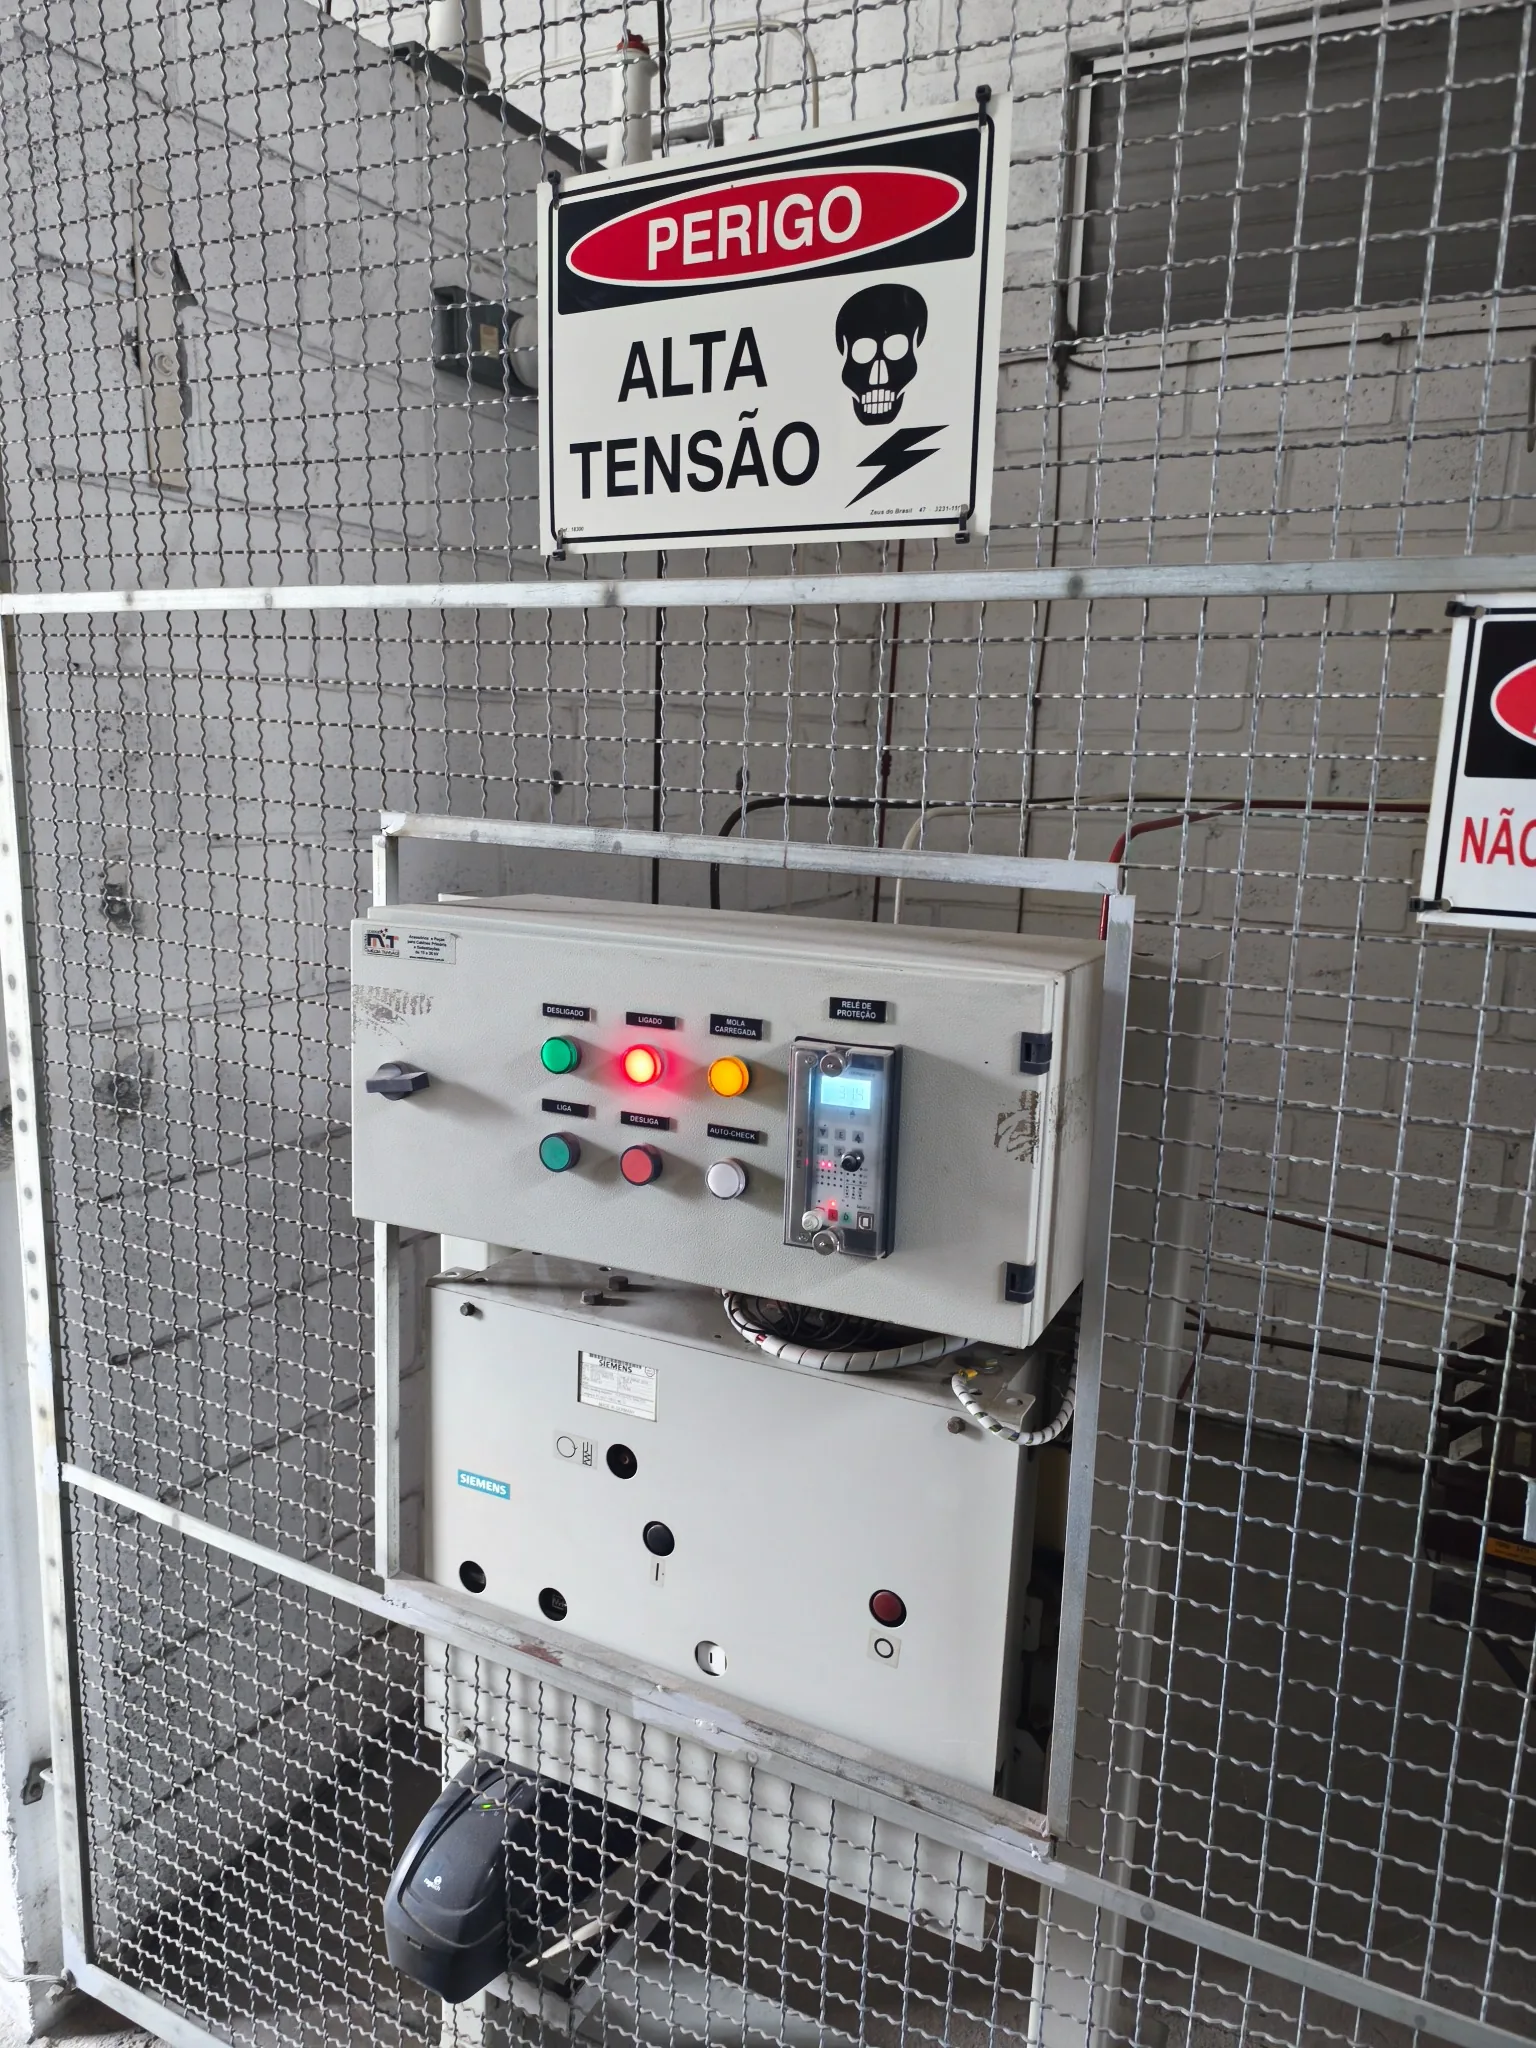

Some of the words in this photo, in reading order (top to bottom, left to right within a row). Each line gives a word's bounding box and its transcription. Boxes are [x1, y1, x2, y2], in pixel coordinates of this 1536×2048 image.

[647, 184, 863, 271] PERIGO
[617, 326, 768, 403] ALTA
[569, 407, 820, 500] TENSÃO
[546, 1006, 584, 1017] DESLIGADO
[861, 1002, 872, 1010] DE
[836, 1008, 877, 1020] PROTEÇÃO
[638, 1016, 663, 1025] LIGADO
[726, 1018, 746, 1027] MOLA
[714, 1025, 756, 1037] CARREGADA
[556, 1104, 572, 1112] LIGA
[629, 1115, 659, 1125] DESLIGA
[709, 1127, 756, 1140] AUTO-CHECK
[598, 1359, 633, 1374] SIEMENS
[459, 1473, 507, 1496] SIEMENS
